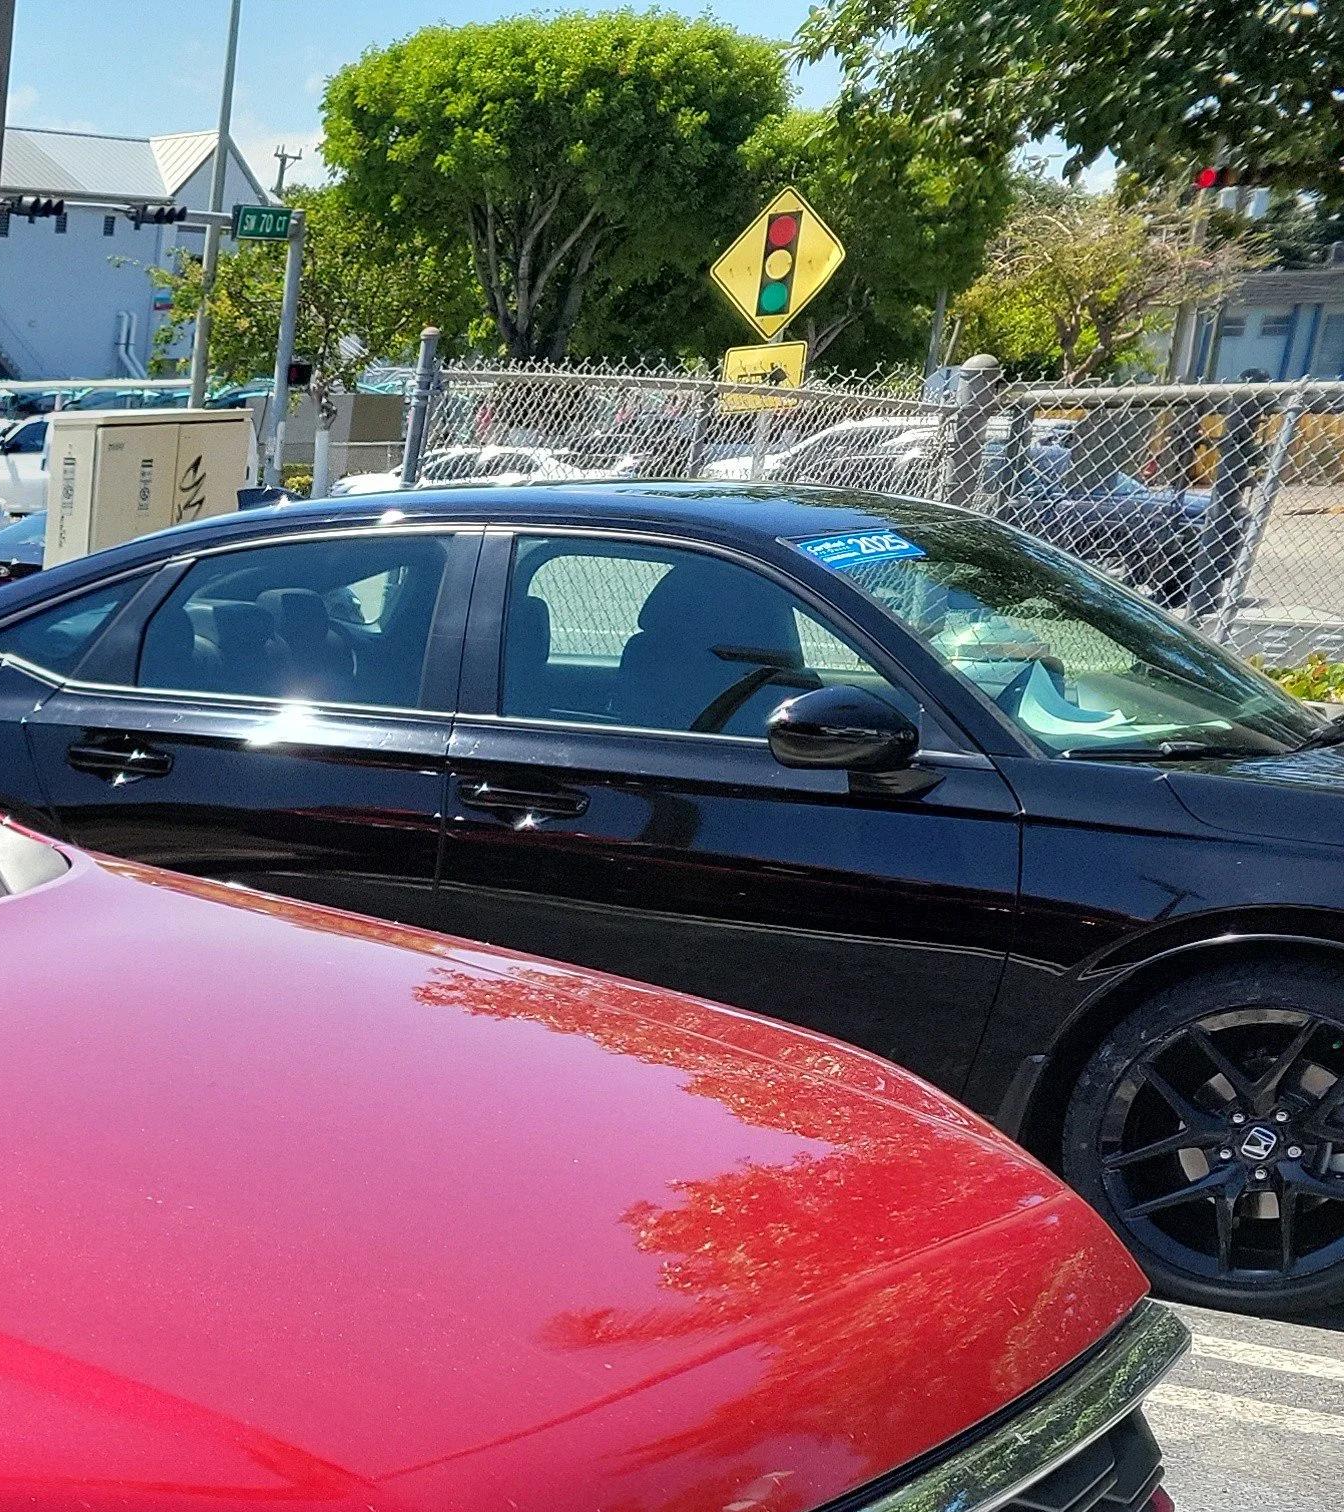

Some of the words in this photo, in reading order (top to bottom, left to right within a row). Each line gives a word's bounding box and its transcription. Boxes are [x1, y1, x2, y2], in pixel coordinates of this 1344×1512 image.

[259, 213, 274, 233] 70
[276, 216, 288, 232] CT
[847, 534, 910, 554] 2025
